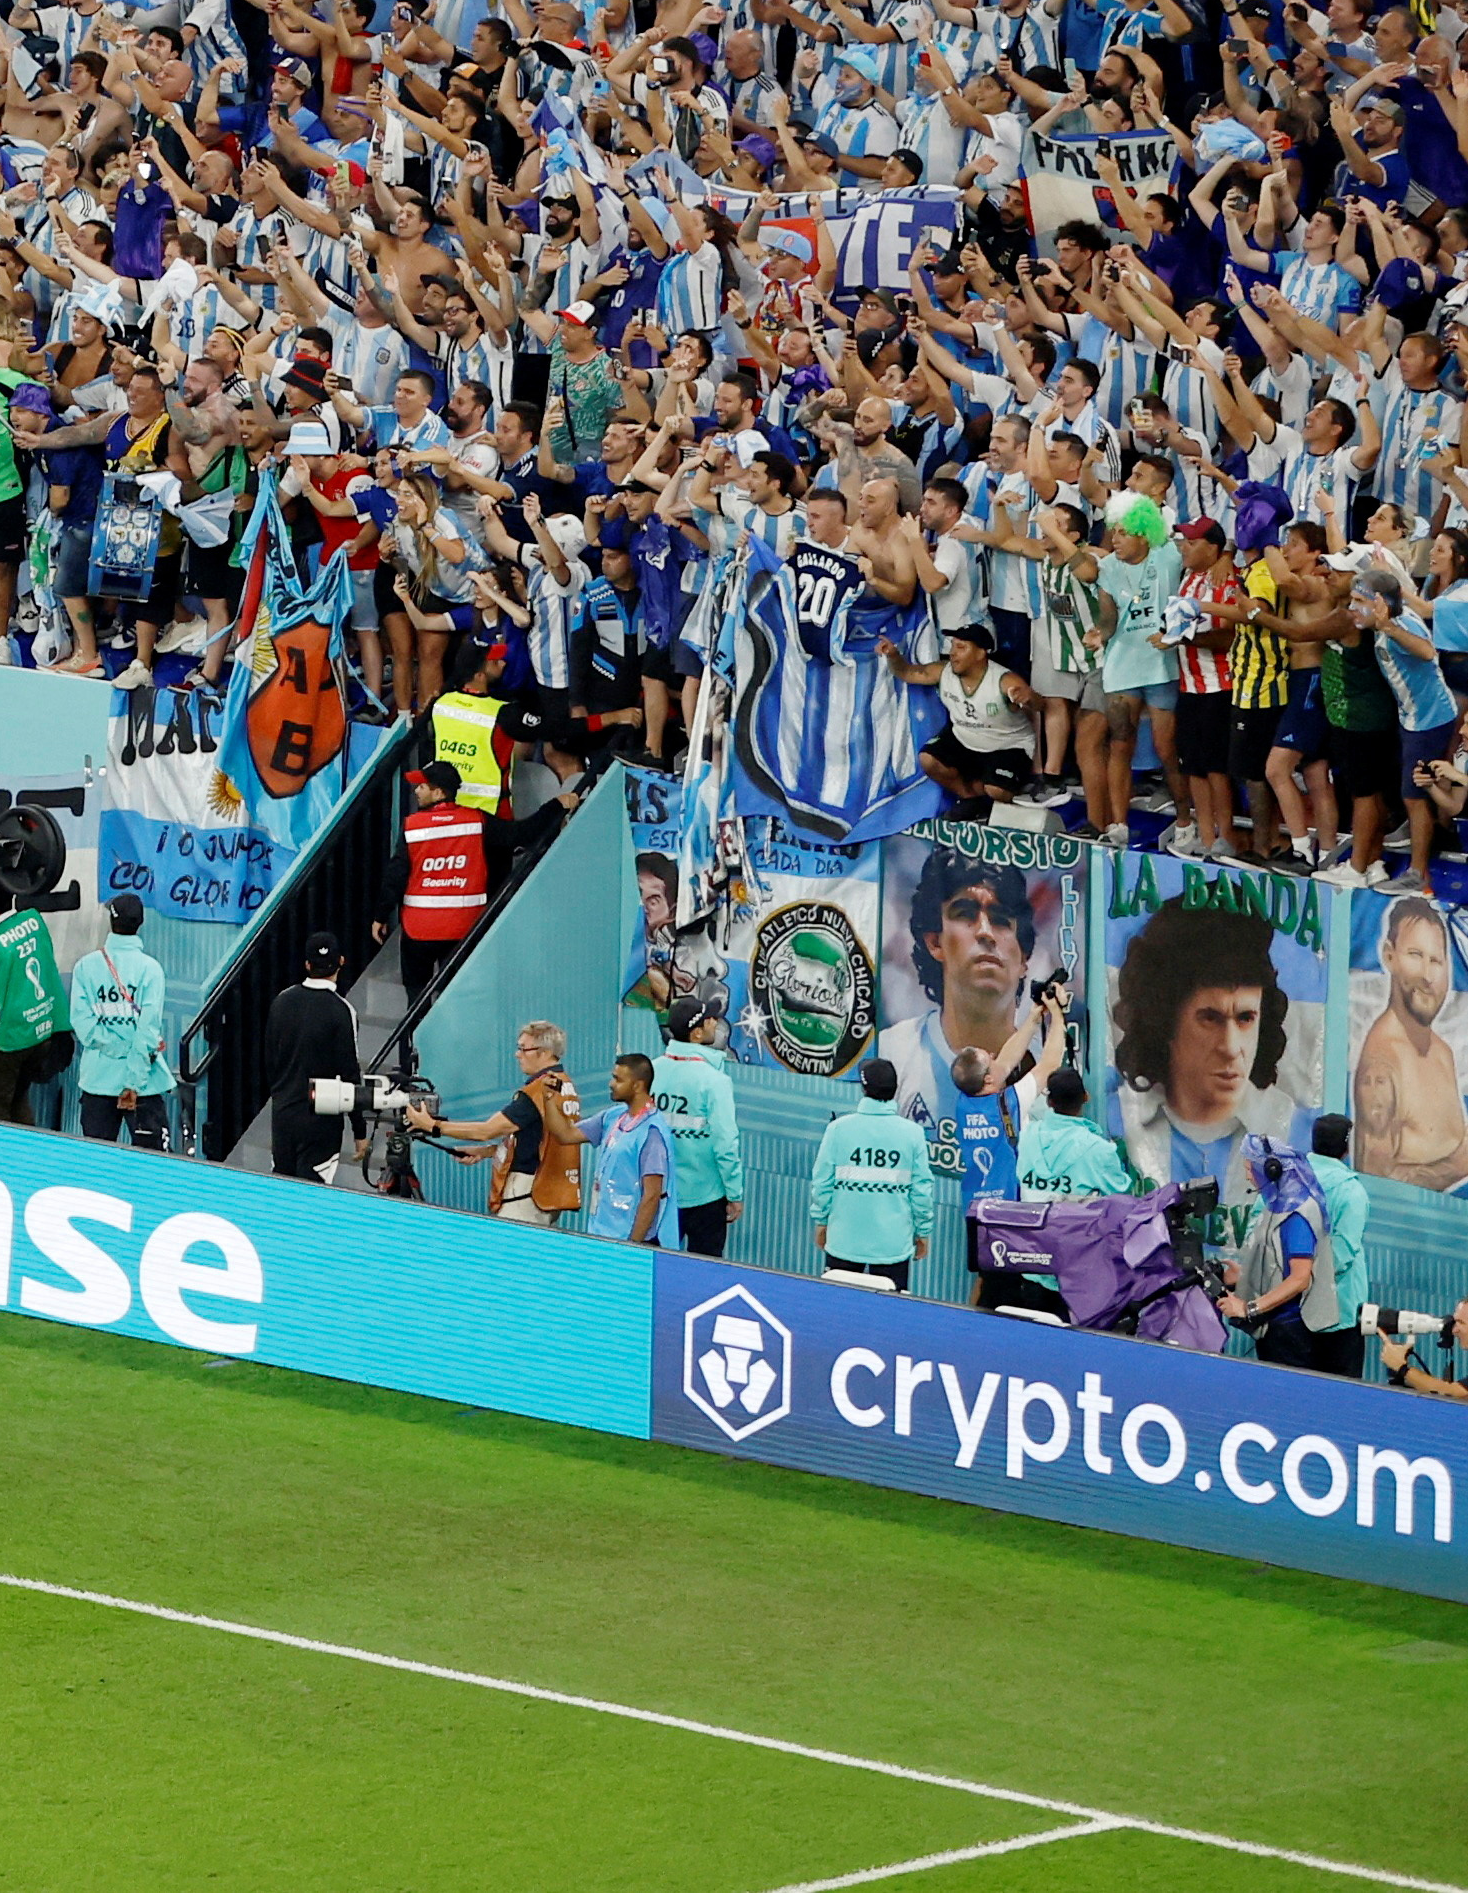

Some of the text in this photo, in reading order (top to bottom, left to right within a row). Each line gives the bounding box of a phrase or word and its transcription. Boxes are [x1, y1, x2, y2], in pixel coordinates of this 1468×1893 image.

[797, 570, 838, 629] 20
[439, 739, 478, 758] 0463
[422, 854, 468, 873] 0019
[421, 875, 468, 890] Security
[1109, 849, 1325, 951] LA BANDA
[14, 937, 37, 959] 237
[966, 1113, 990, 1127] FIFA
[962, 1125, 1000, 1141] PHOTO
[848, 1147, 902, 1169] 4189
[830, 1346, 1452, 1544] crypto.com
